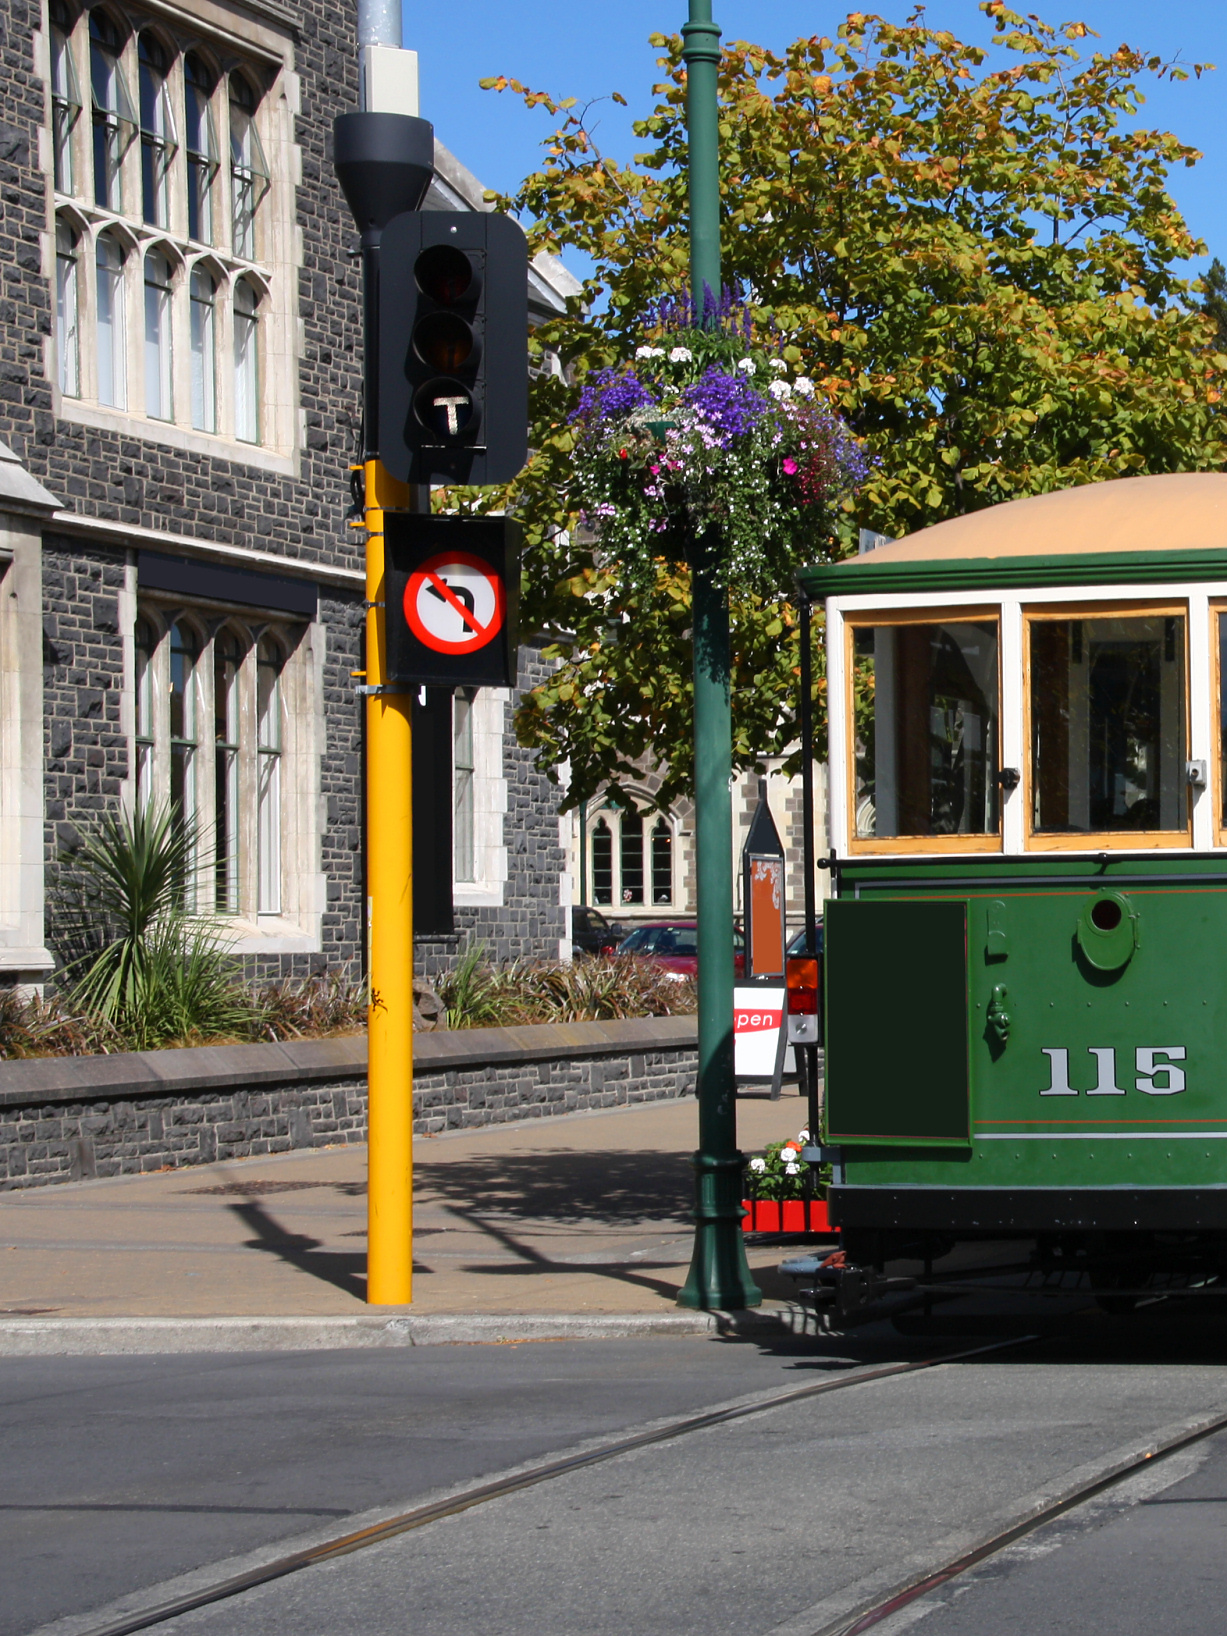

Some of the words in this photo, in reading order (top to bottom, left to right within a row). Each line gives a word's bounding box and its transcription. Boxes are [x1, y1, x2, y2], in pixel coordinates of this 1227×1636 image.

[433, 396, 469, 435] T
[734, 1014, 773, 1029] pen
[1039, 1046, 1187, 1096] 115
